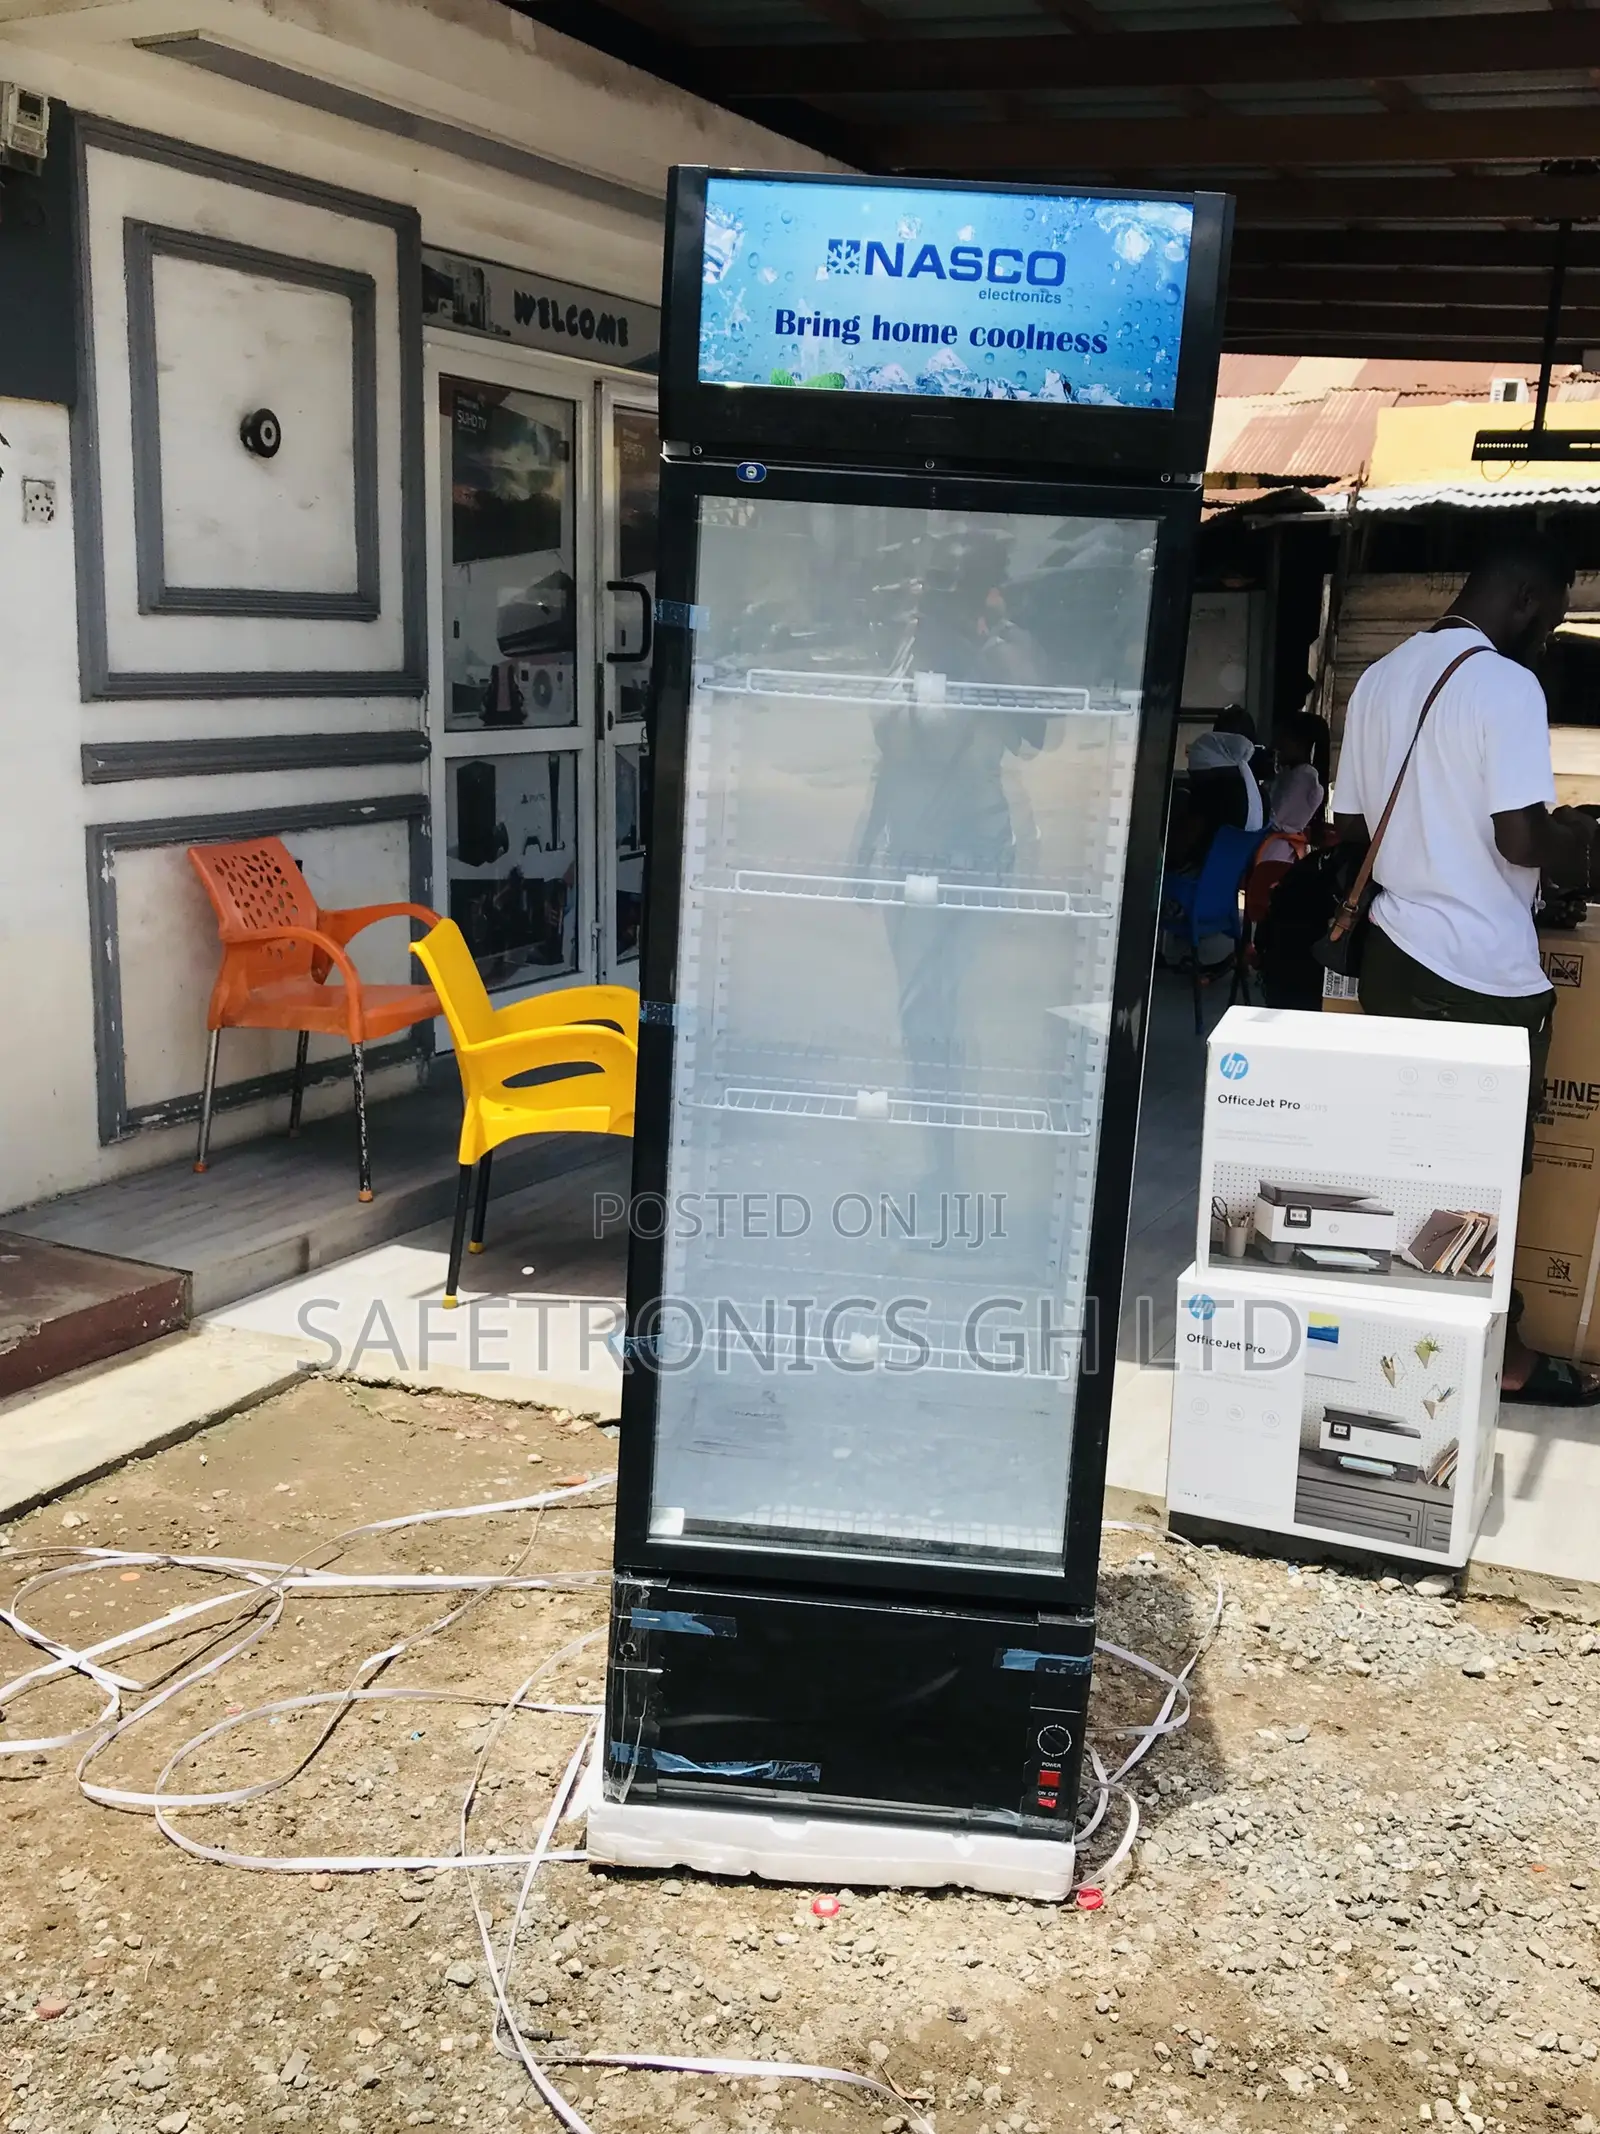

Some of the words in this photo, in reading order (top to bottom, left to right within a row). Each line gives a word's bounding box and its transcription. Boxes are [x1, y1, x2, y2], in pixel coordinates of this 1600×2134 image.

[864, 240, 1066, 287] NASCO
[979, 287, 1061, 304] electronics
[514, 289, 629, 347] WELCOME
[775, 308, 861, 345] Bring
[872, 315, 958, 344] home
[969, 323, 1108, 354] coolness
[1220, 1052, 1248, 1080] hp
[1218, 1094, 1275, 1108] OfficeJet
[1280, 1099, 1301, 1110] Pro
[1188, 1293, 1216, 1320] hp
[1187, 1333, 1241, 1351] OfficeJet
[1245, 1343, 1266, 1354] Pro
[1041, 1761, 1062, 1769] POWER
